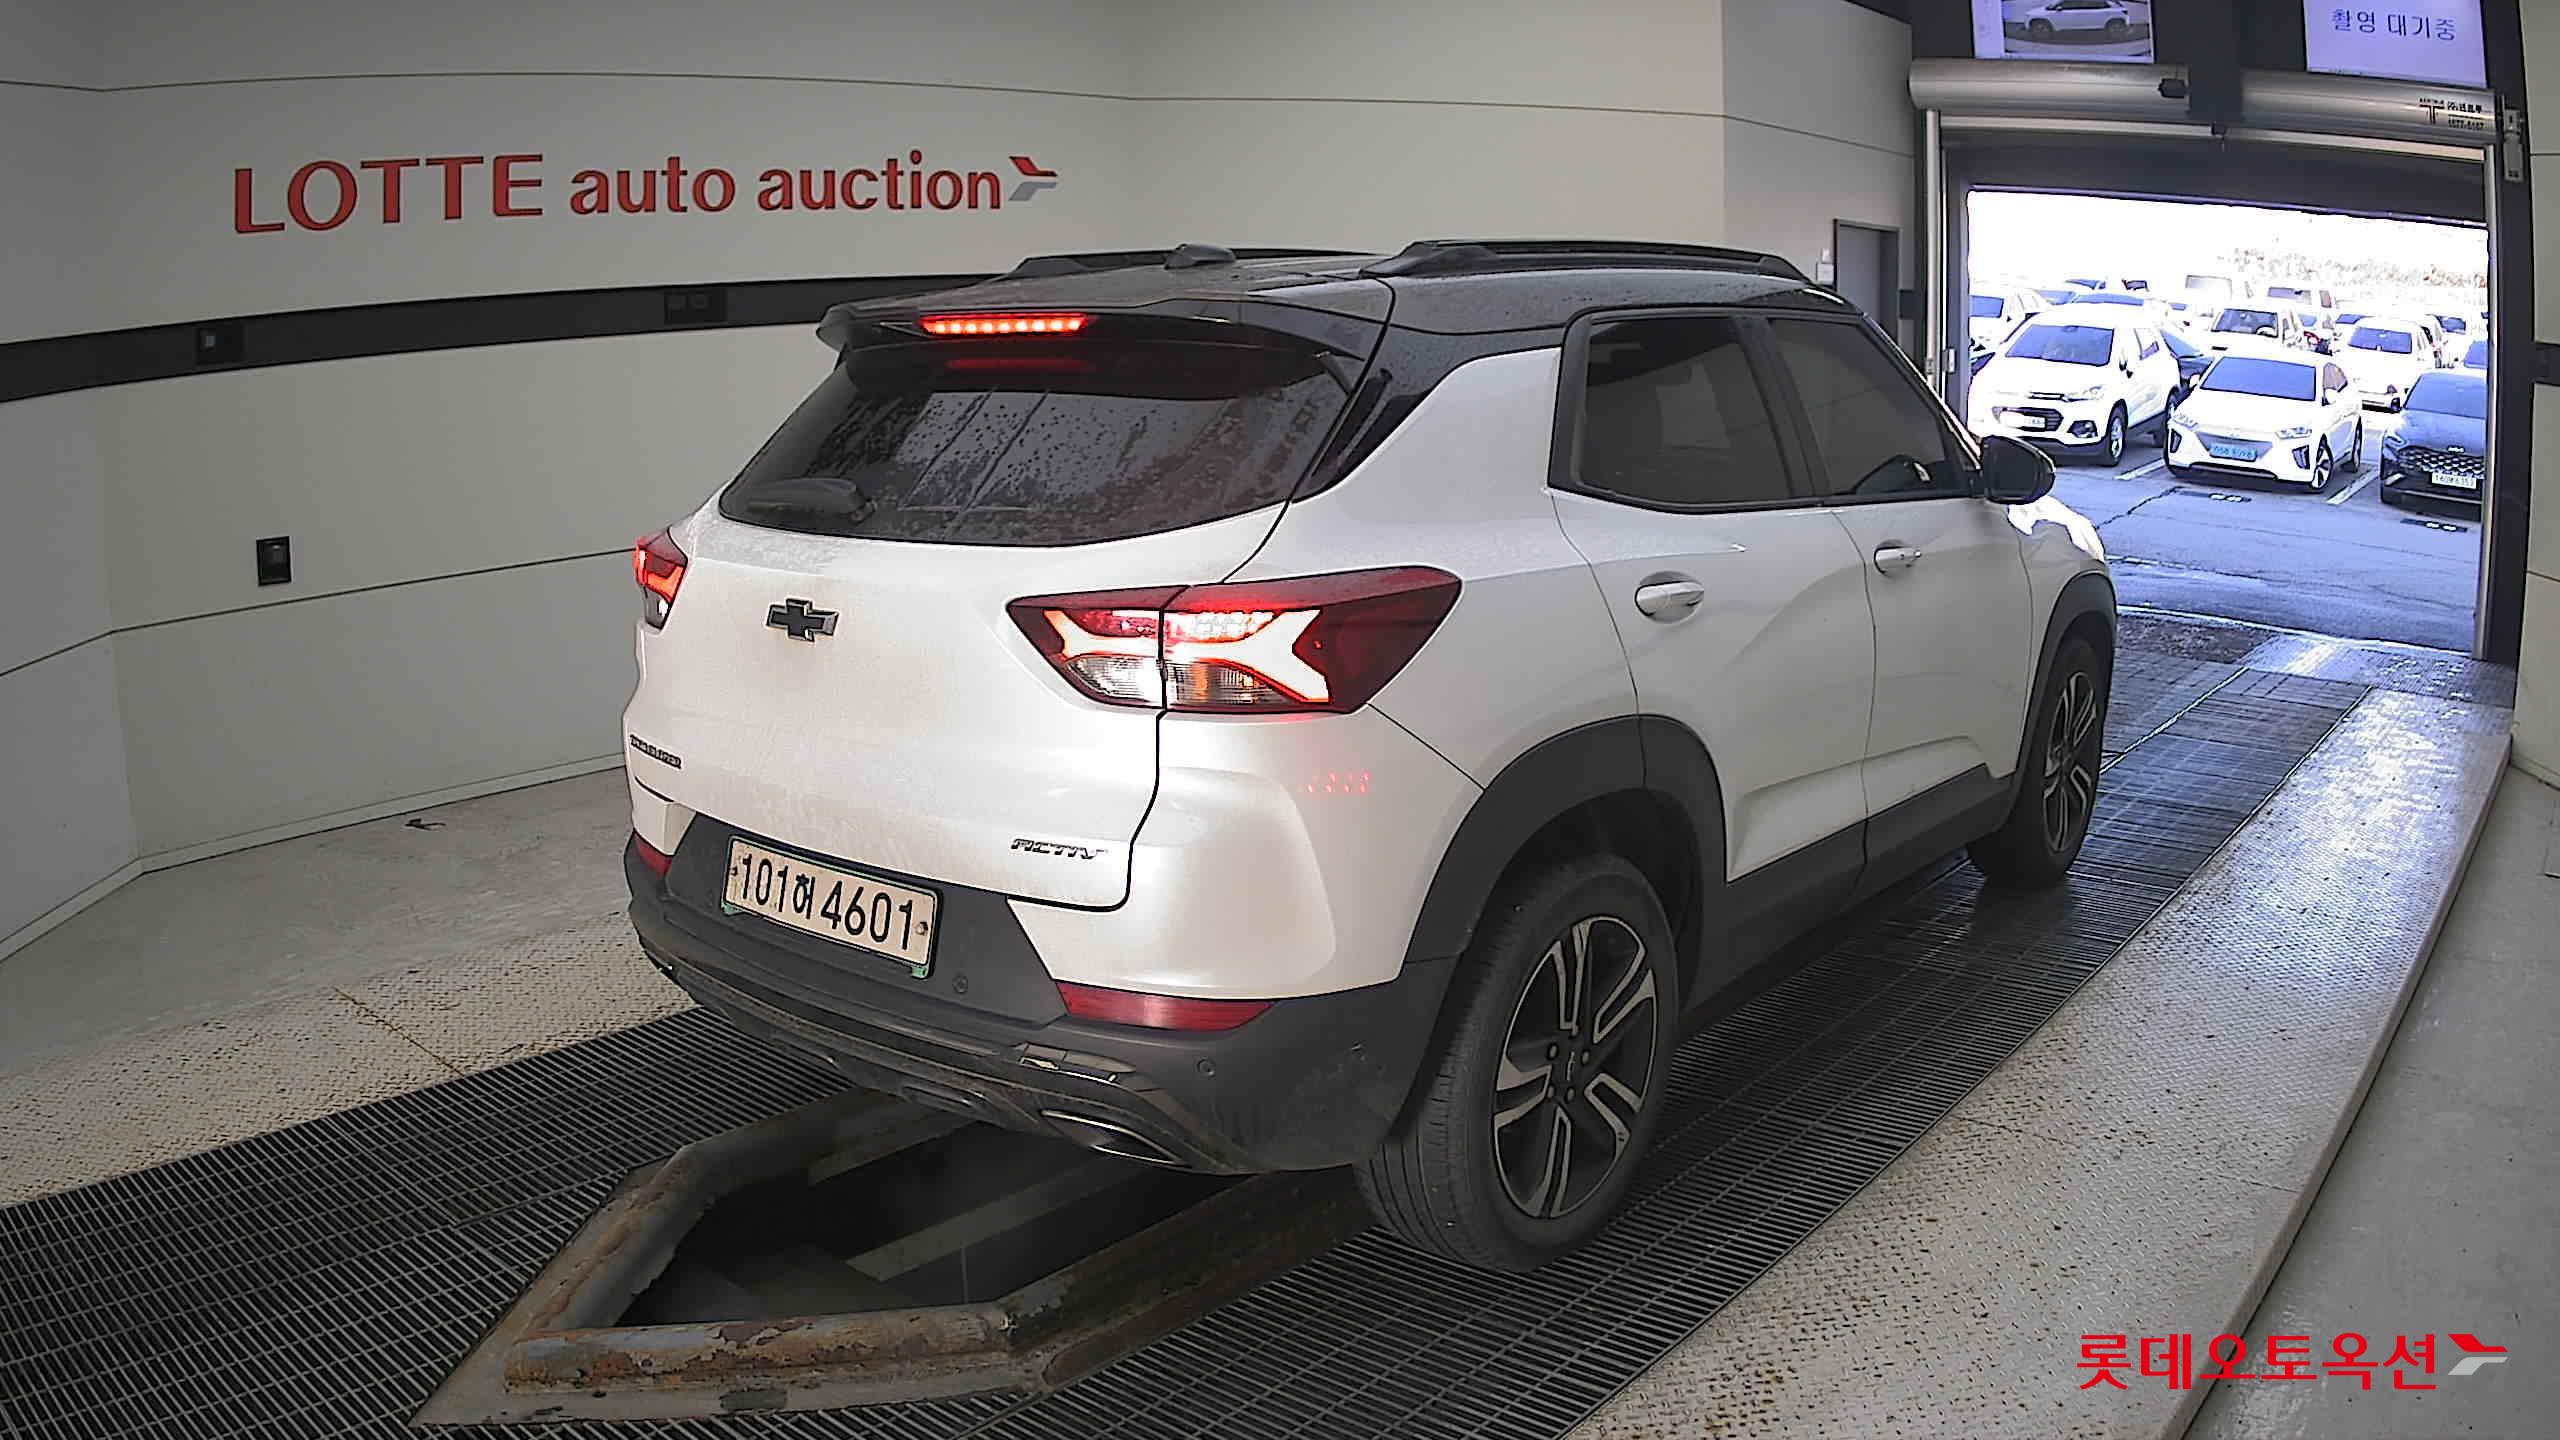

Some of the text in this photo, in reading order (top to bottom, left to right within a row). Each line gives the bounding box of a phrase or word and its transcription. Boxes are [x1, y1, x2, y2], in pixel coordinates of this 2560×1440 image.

[2332, 8, 2456, 41] 촬영 대기중
[235, 150, 1003, 234] LOTTE auto auction
[1011, 838, 1104, 860] ACTIV
